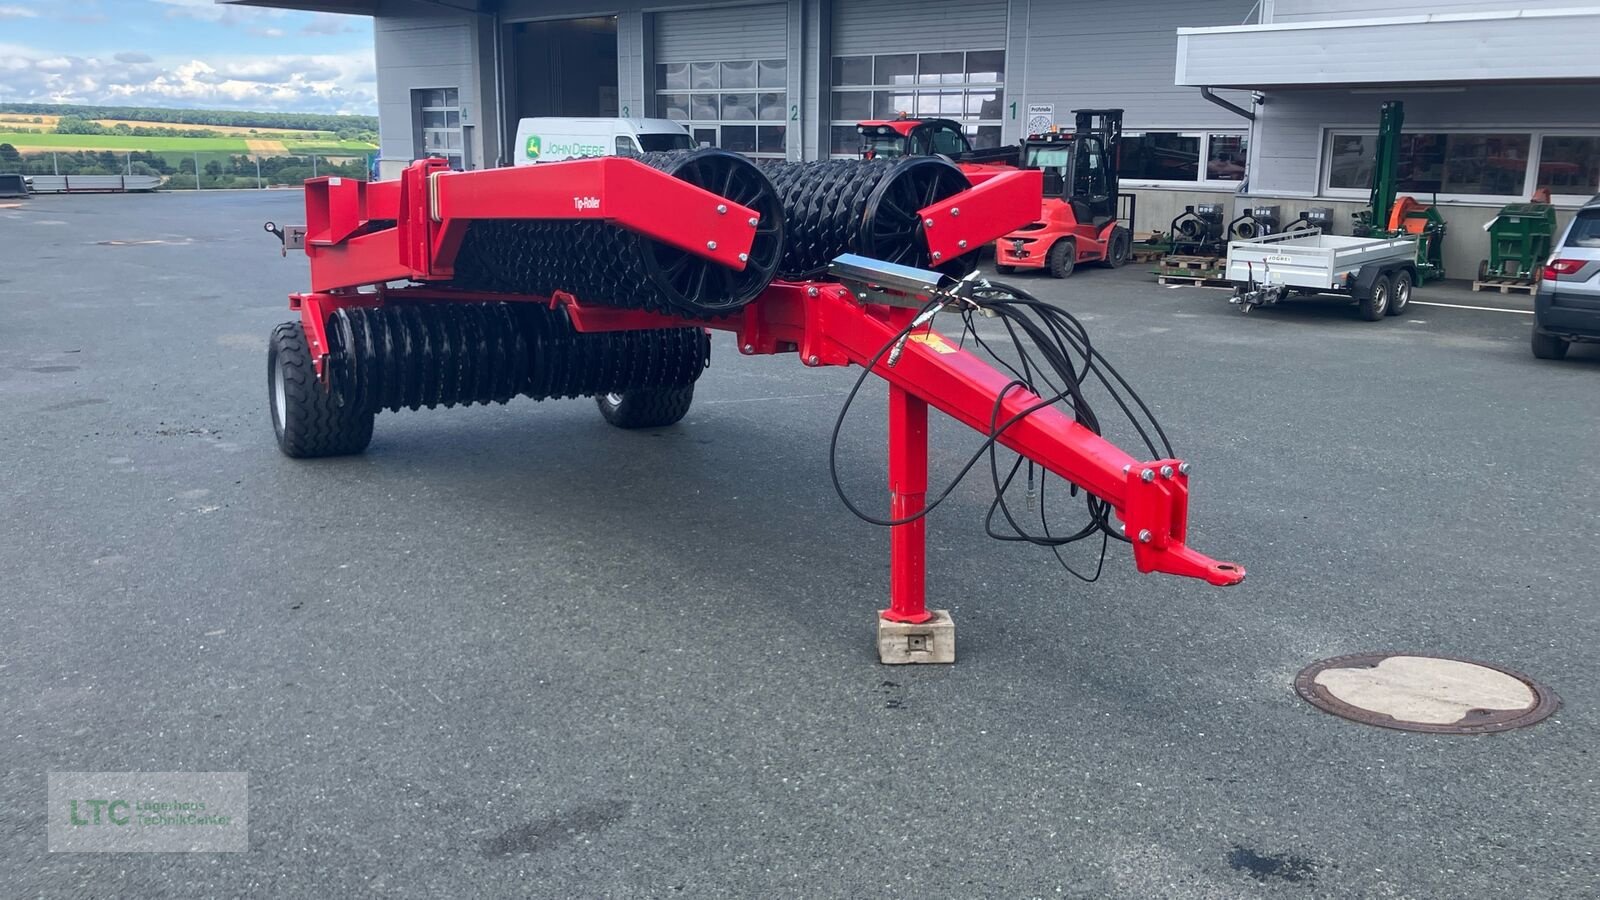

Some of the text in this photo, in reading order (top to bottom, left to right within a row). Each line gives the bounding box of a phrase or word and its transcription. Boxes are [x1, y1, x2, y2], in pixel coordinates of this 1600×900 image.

[622, 105, 630, 118] 3
[791, 104, 798, 120] 2
[1009, 101, 1016, 120] 1
[545, 142, 605, 156] JOHN DEERE
[573, 197, 600, 212] Tip-Roller
